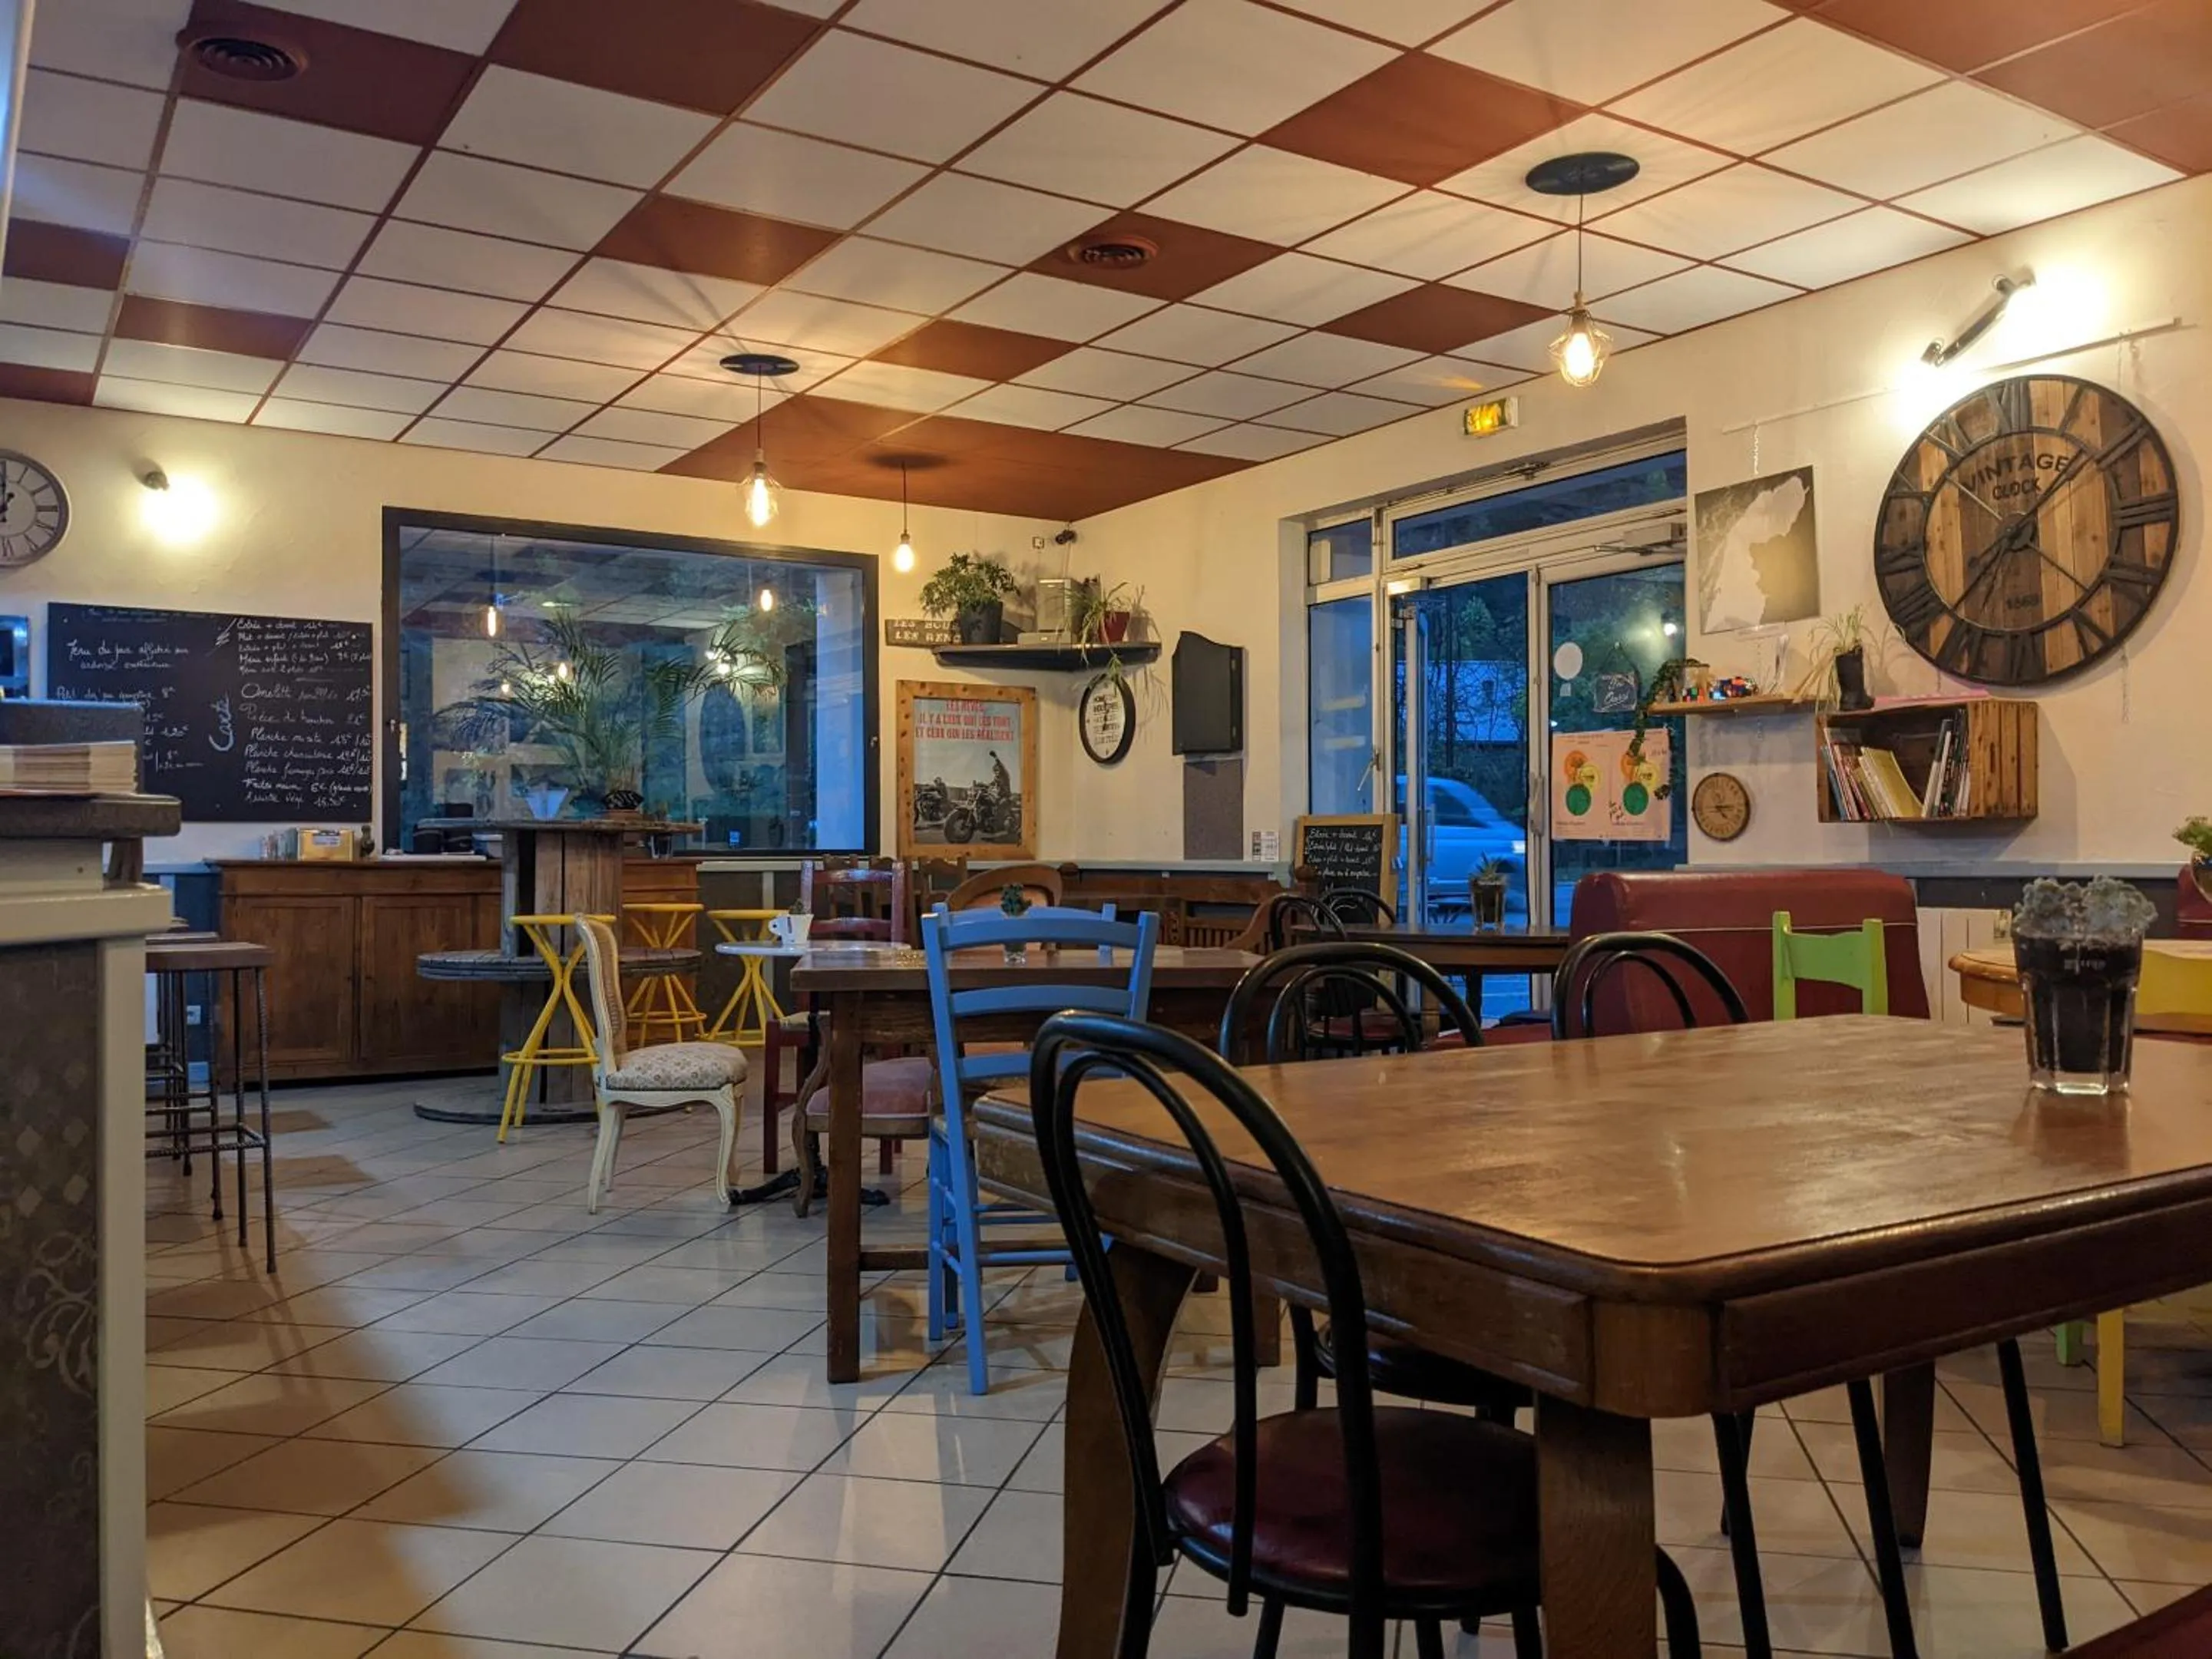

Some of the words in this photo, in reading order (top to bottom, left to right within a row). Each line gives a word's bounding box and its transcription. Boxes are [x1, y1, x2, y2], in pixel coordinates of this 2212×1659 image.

[1963, 452, 2071, 492] VINTAGE
[1992, 478, 2042, 501] CLOCK
[894, 630, 919, 640] LES
